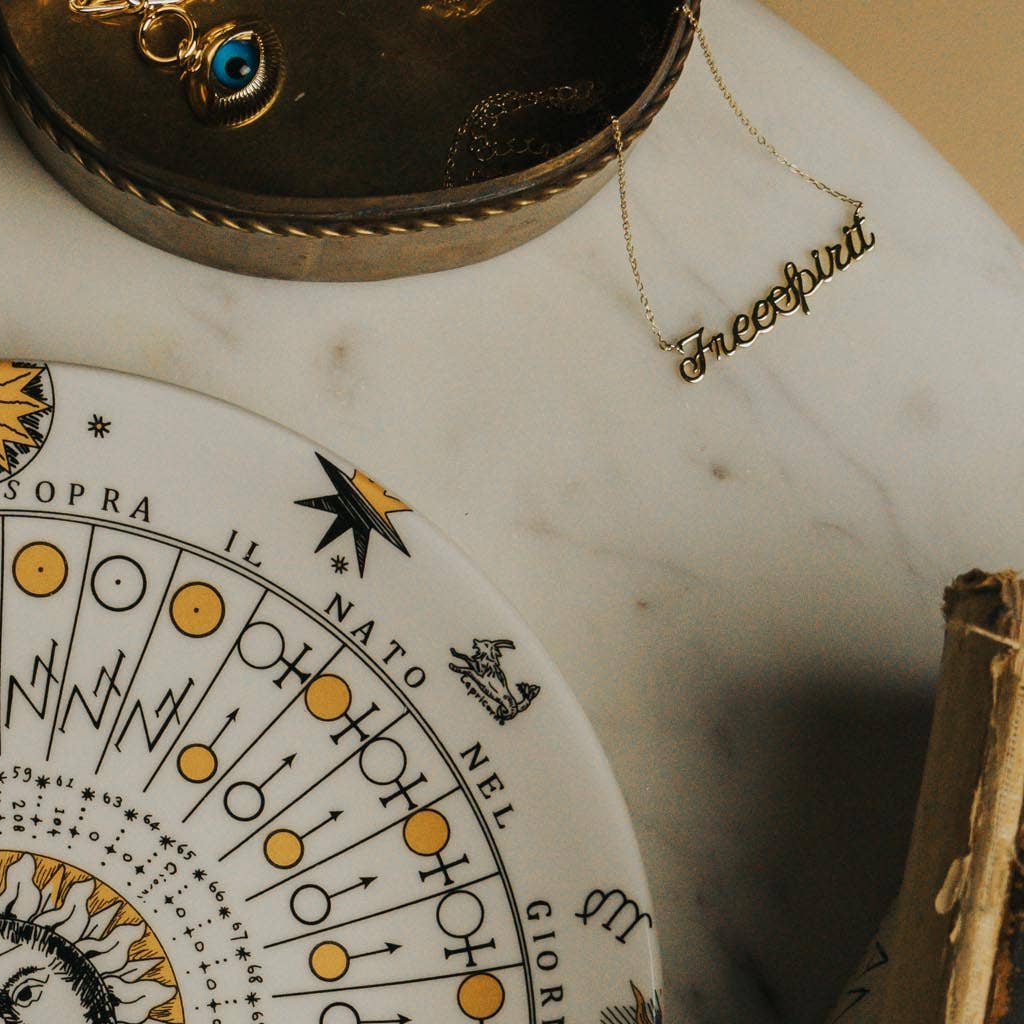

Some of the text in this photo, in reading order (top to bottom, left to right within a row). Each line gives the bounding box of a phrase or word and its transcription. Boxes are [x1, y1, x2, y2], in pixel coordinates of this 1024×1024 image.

[4, 480, 150, 523] SOPRA
[224, 529, 262, 568] IL
[324, 592, 426, 688] NATO
[459, 741, 514, 829] NEL
[12, 766, 32, 783] 59
[103, 792, 123, 808] 63
[177, 844, 197, 860] 65
[209, 881, 225, 902] 66
[230, 922, 248, 941] 67
[247, 965, 263, 983] 68
